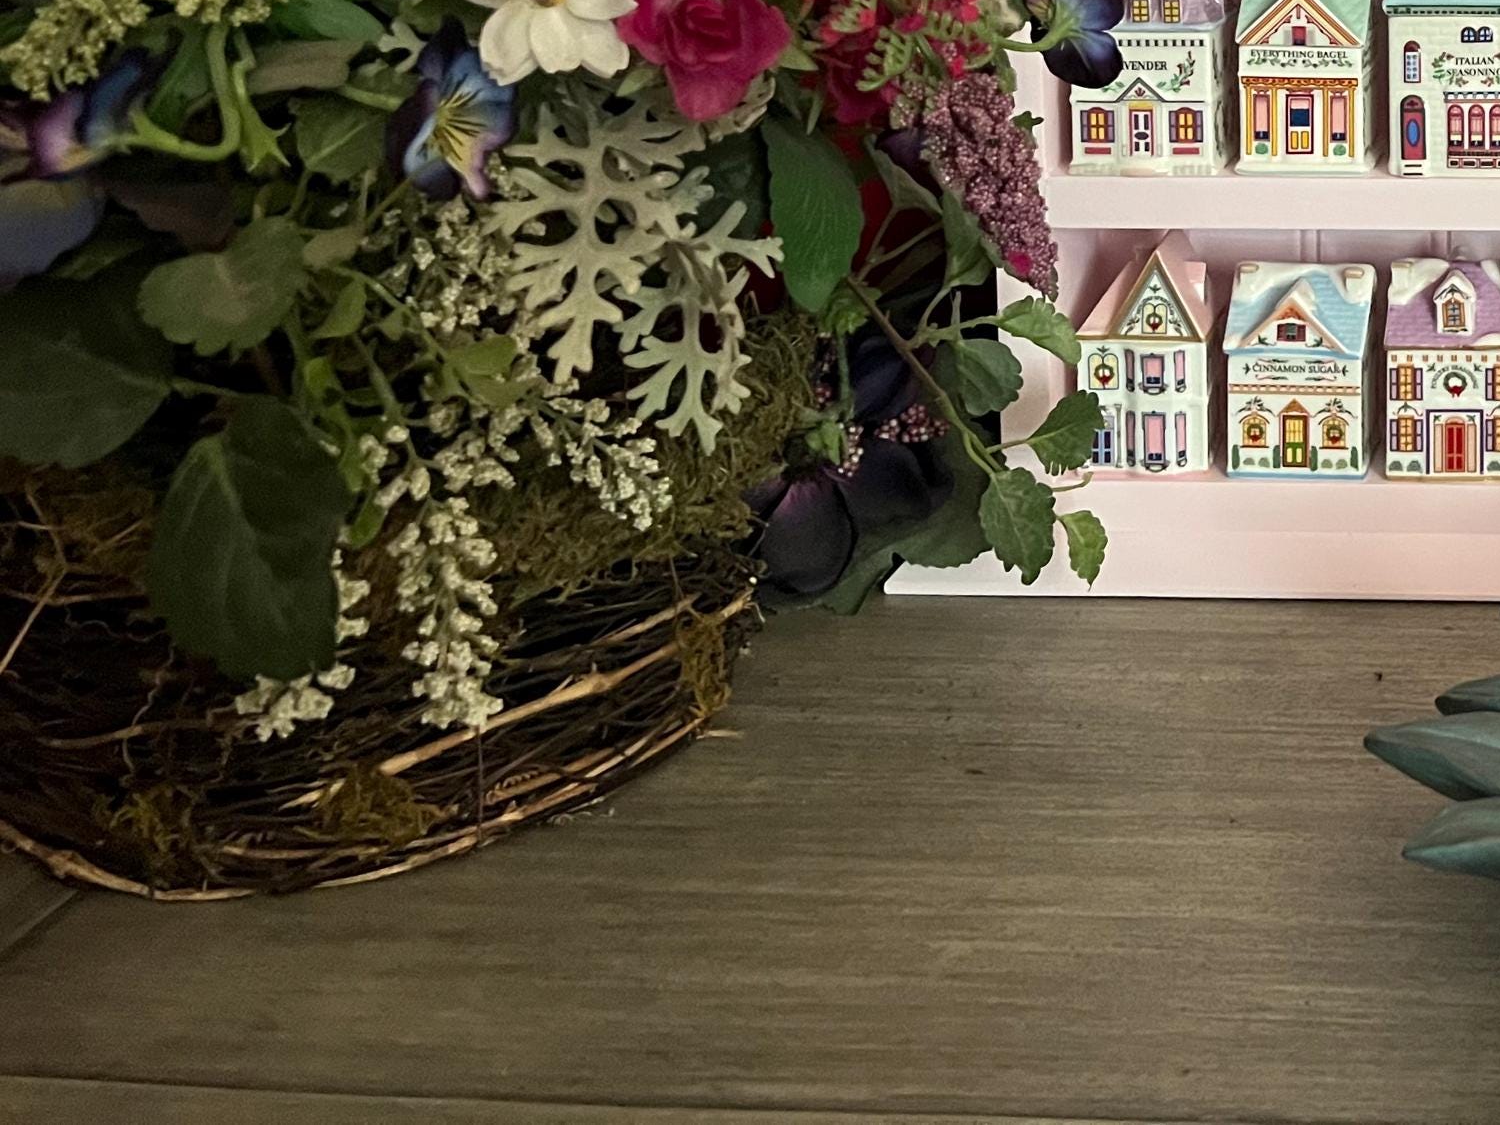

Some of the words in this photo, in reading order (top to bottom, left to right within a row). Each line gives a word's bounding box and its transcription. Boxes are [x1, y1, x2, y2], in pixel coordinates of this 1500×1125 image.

[1250, 49, 1314, 59] EVERYTHING
[1316, 50, 1348, 59] BAGEL
[1123, 60, 1168, 71] VENDER
[1455, 56, 1495, 65] ITALIAN
[1252, 363, 1306, 374] CINNAMON
[1308, 365, 1340, 374] SUGAR
